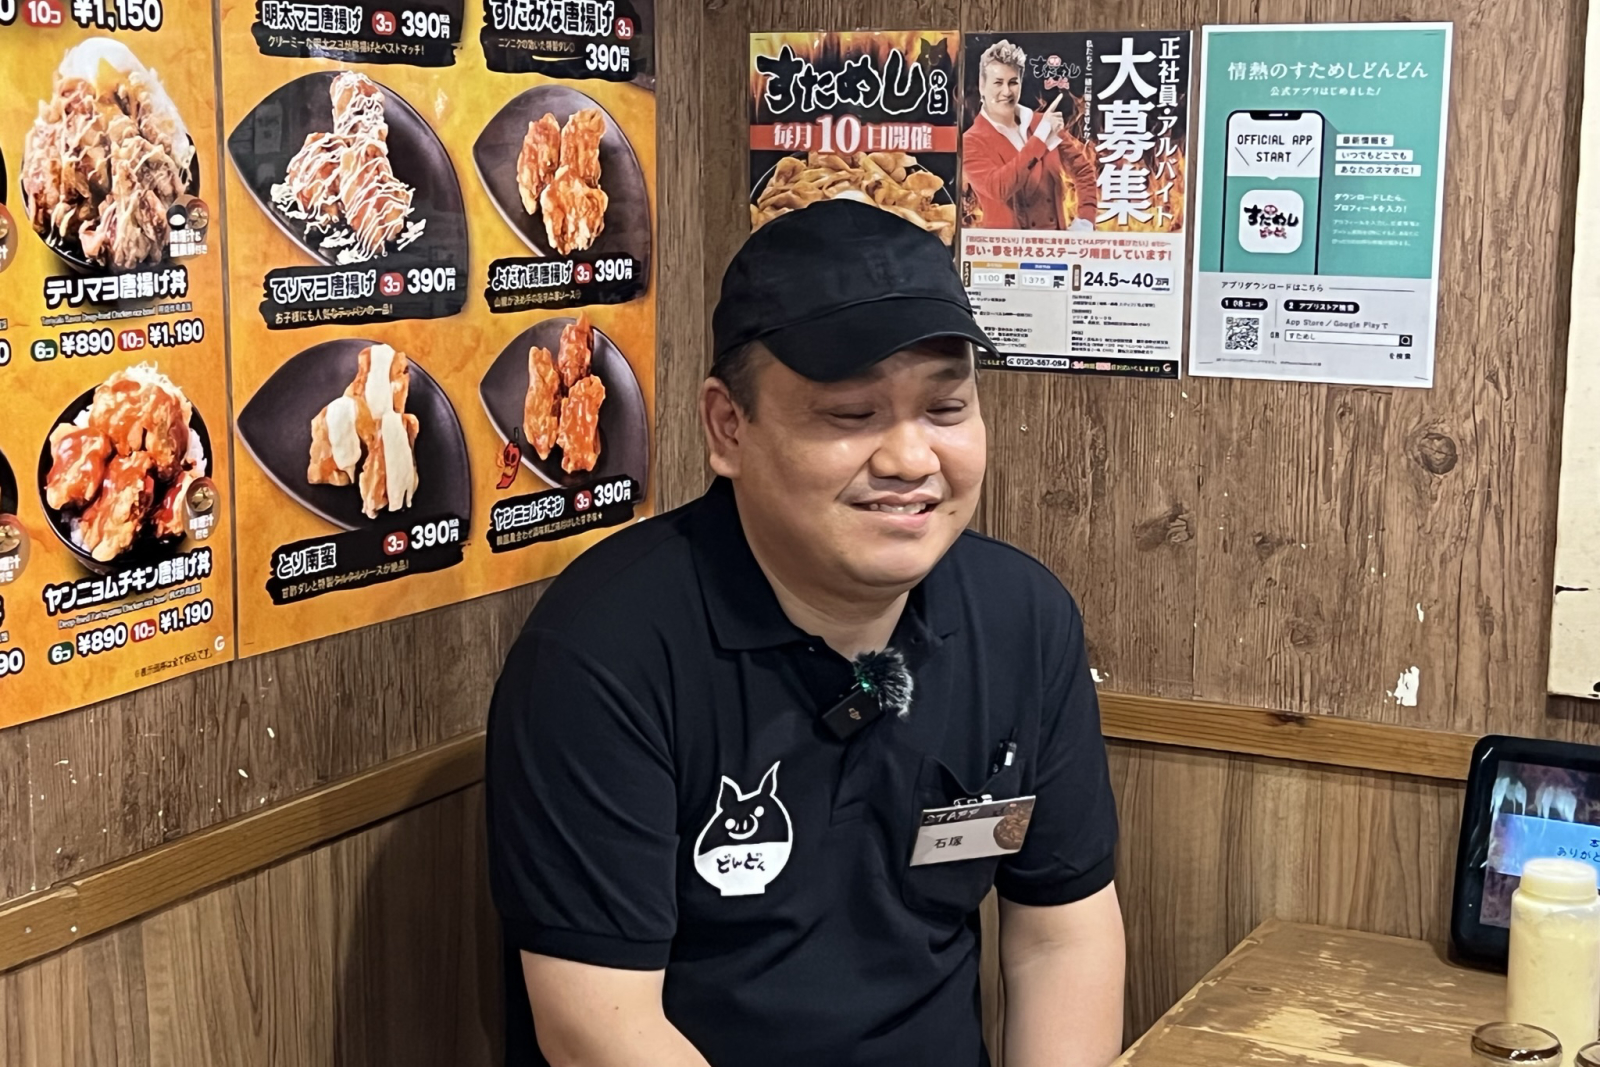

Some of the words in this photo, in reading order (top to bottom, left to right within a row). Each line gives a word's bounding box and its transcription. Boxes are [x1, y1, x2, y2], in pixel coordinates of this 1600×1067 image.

[73, 0, 161, 28] ¥1,150
[262, 1, 363, 34] 明太マヨ唐揚げ
[755, 44, 926, 115] すためし
[1228, 62, 1429, 81] 情熱のすためしどんどん
[773, 114, 933, 154] 毎月10日開催
[1095, 37, 1158, 226] 大募集
[1154, 36, 1181, 227] 正社員・アルバイト
[1237, 134, 1285, 145] OFFICIAL
[1292, 134, 1313, 145] APP
[1256, 151, 1292, 163] START
[1341, 151, 1407, 160] いつでもどこでも
[1243, 204, 1299, 227] すためし
[45, 268, 188, 306] テリマヨ唐揚げ丼
[269, 269, 377, 304] てりマヨ唐揚げ
[1023, 276, 1046, 284] 1375
[1221, 281, 1324, 292] アプリダウンロードはこちら
[61, 330, 114, 357] ¥890
[149, 320, 204, 347] ¥1,190
[1286, 318, 1301, 328] App
[1303, 318, 1324, 327] Store
[1334, 320, 1360, 330] Google
[276, 542, 337, 580] とり南蛮
[44, 550, 211, 613] ヤンニョムチキン唐揚げ丼
[77, 625, 127, 654] ¥890
[160, 601, 213, 632] ¥1,190
[924, 808, 980, 824] STAFF
[716, 852, 765, 874] どんどん
